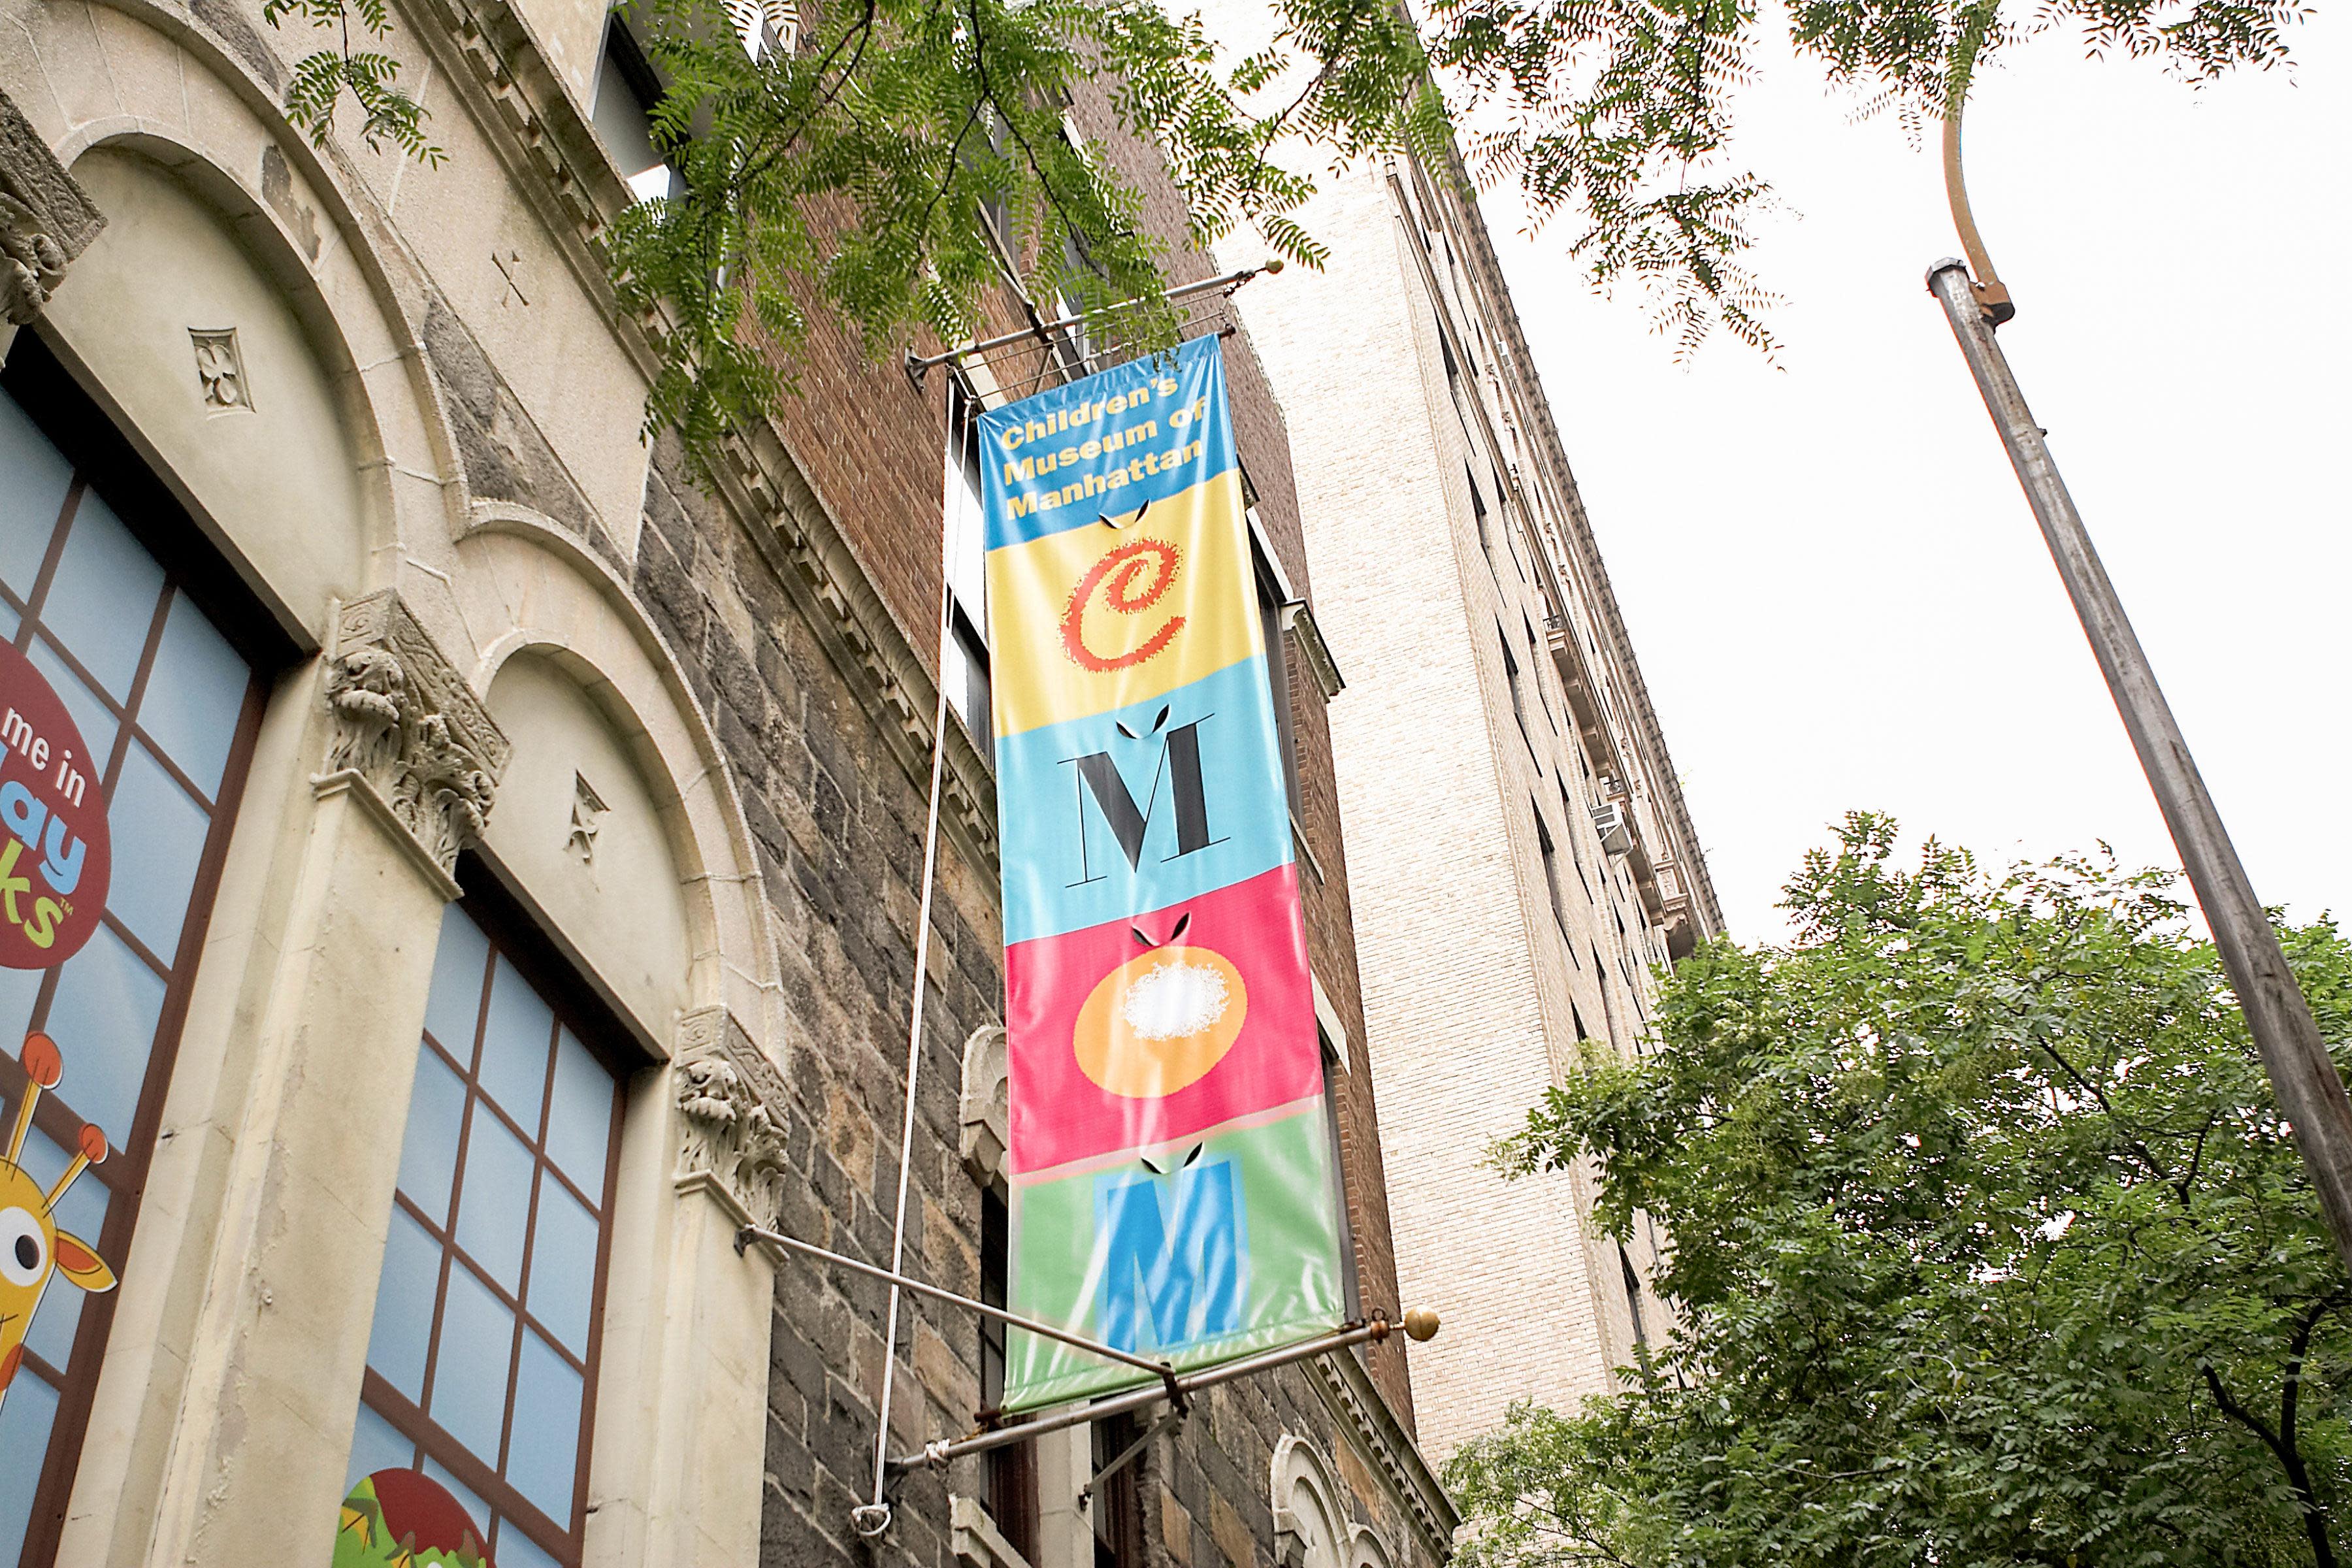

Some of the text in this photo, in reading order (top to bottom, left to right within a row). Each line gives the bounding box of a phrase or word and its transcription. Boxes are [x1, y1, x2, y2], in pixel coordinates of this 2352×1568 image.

[1001, 377, 1179, 451] Children's
[1004, 396, 1206, 486] Museum of
[1007, 439, 1203, 520] Manhattan
[0, 739, 86, 895] ay
[56, 749, 86, 808] in
